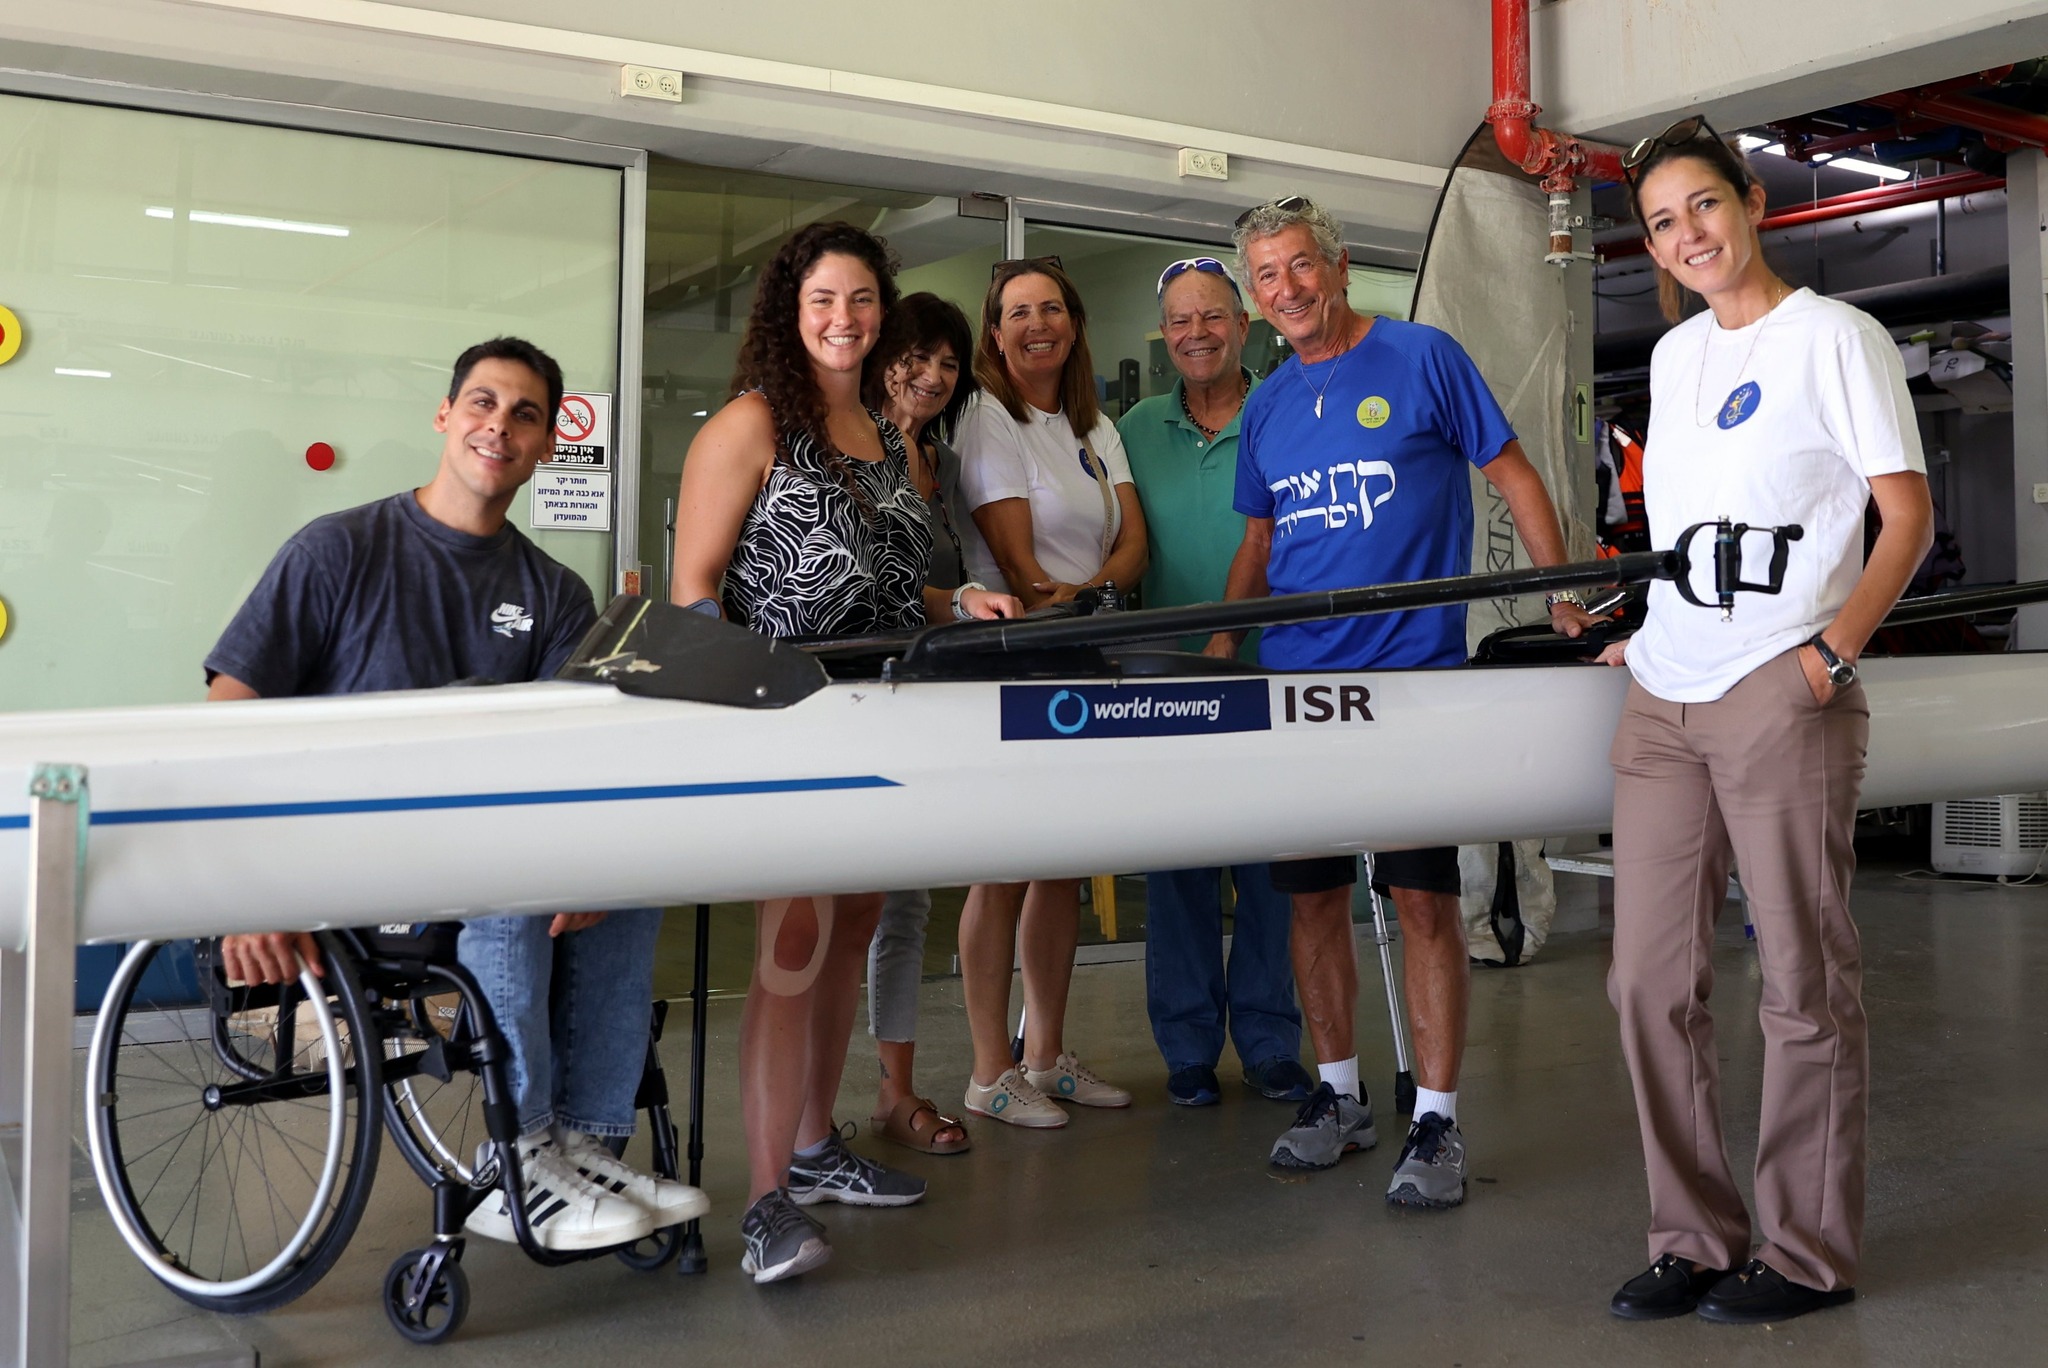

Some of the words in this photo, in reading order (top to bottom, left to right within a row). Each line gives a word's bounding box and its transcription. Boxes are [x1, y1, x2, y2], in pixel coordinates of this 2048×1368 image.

[580, 446, 594, 455] אין
[552, 454, 594, 463] לאופניים
[556, 477, 568, 485] יקר
[1269, 469, 1322, 502] אור
[537, 488, 560, 496] המיזוג
[591, 490, 605, 498] אנא
[1328, 459, 1396, 530] קרן
[544, 500, 568, 509] בצאתך
[570, 501, 598, 509] והאורות
[554, 513, 587, 522] מהמועדון
[497, 602, 525, 616] NIKE
[1284, 684, 1375, 723] ISR
[1094, 696, 1152, 720] world
[1153, 699, 1221, 721] rowing
[379, 923, 411, 935] VICAIR
